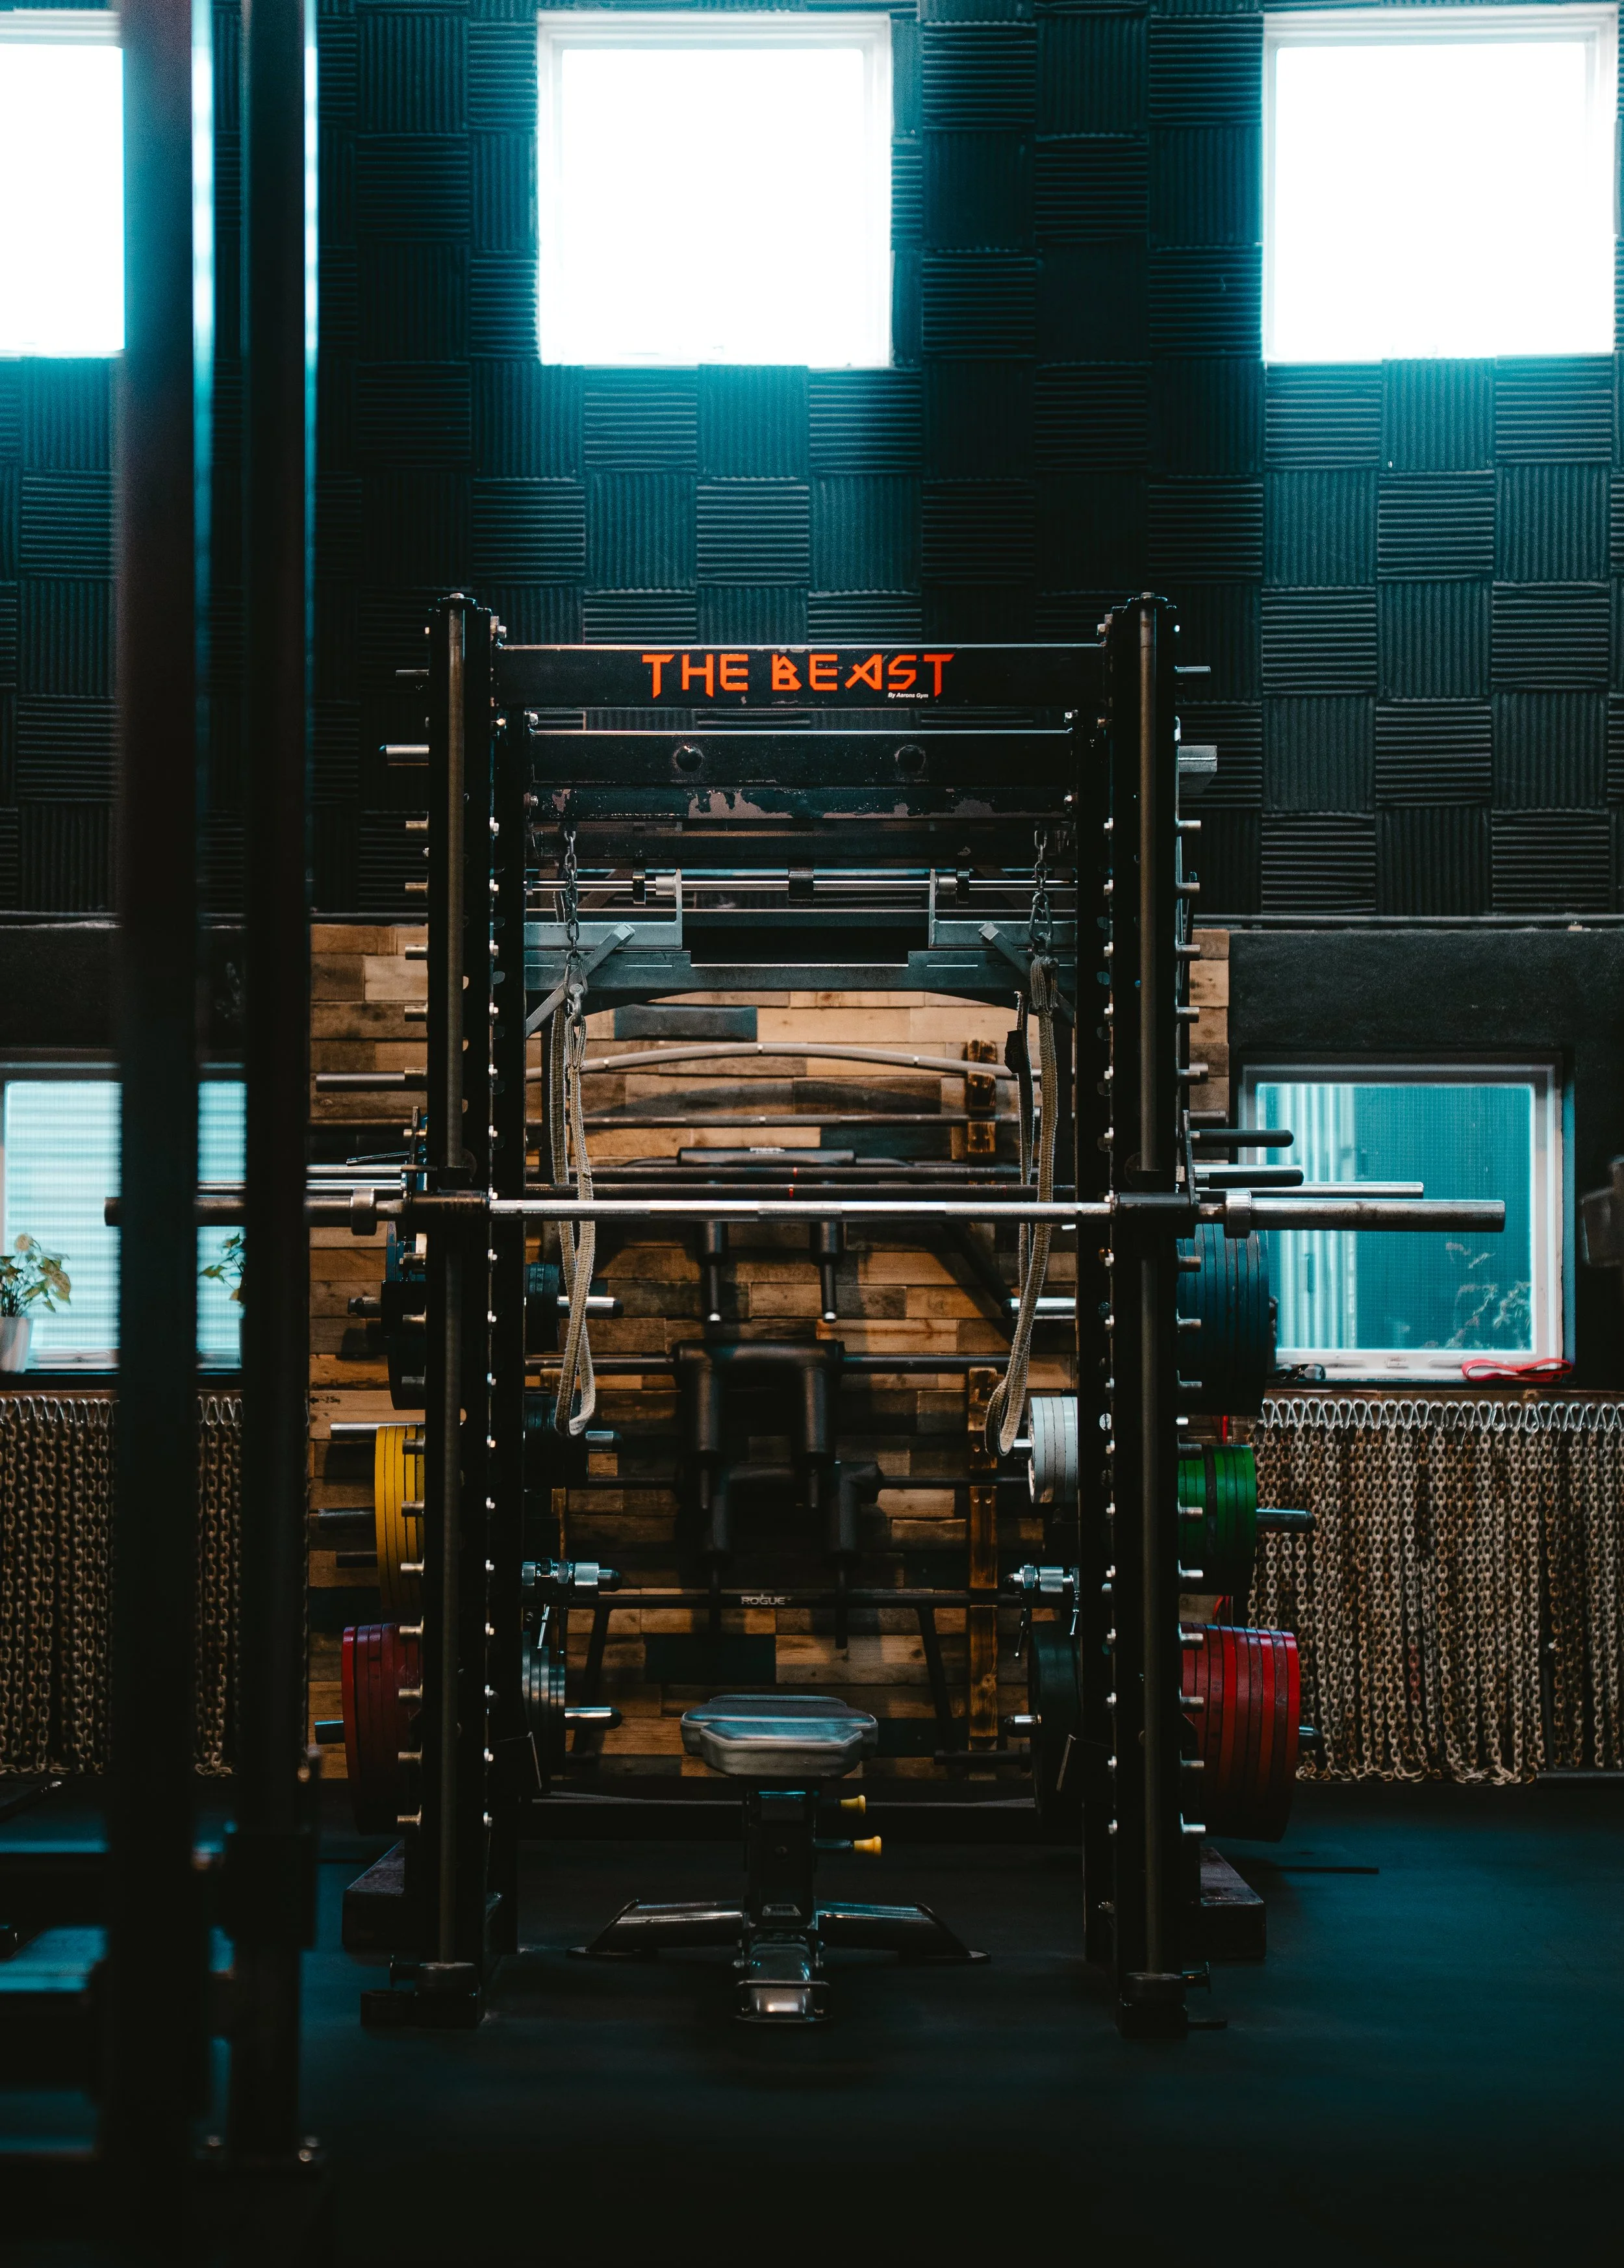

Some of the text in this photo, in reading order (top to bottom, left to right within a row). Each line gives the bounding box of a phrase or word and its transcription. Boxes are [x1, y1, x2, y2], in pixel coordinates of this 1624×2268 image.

[642, 654, 954, 698] THE BEAST
[741, 1594, 785, 1605] ROGUE
